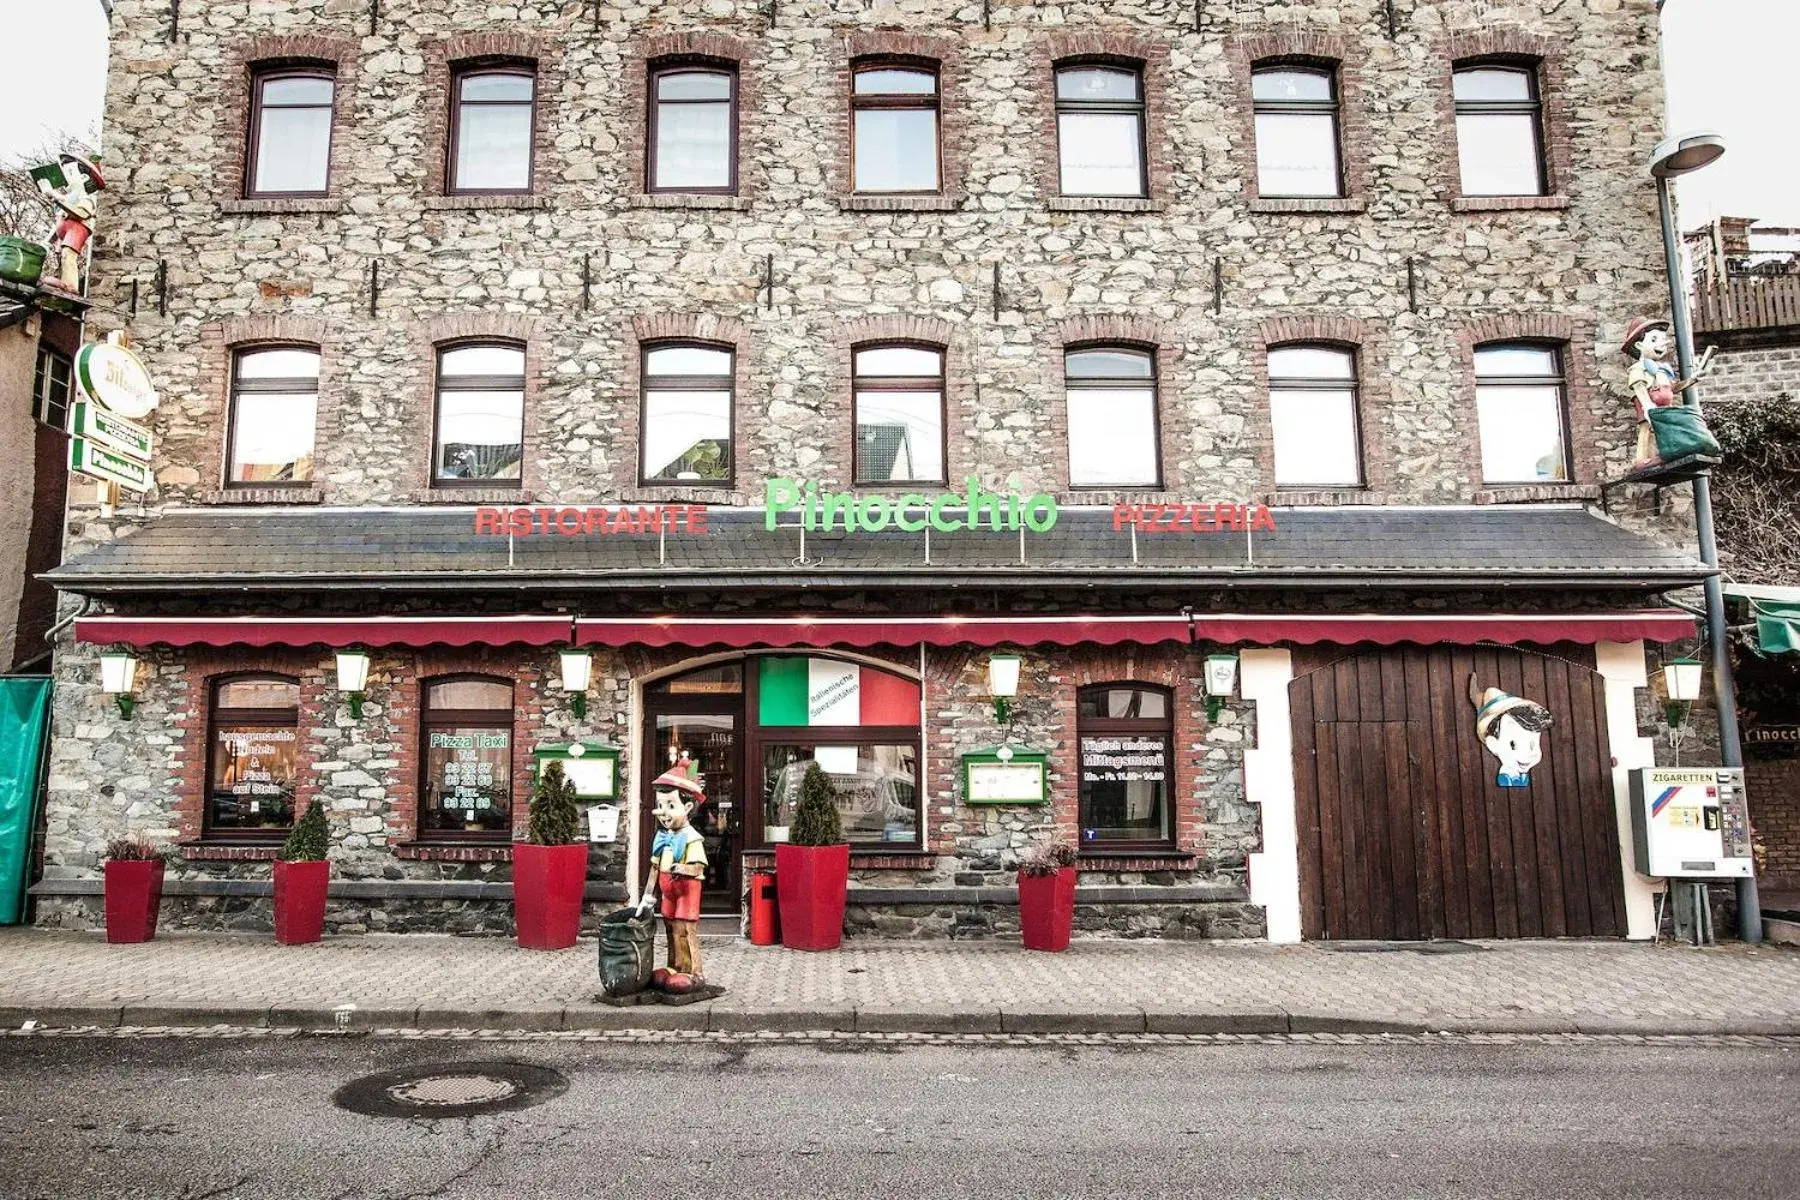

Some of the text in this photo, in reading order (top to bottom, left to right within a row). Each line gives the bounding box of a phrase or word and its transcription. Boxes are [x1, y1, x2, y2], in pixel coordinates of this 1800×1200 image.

[475, 475, 1277, 537] RISTORANTE Pinocchio PIZZERIA
[810, 672, 854, 703] Italienische
[810, 684, 859, 717] Spezialitäten
[430, 733, 508, 749] Pizza Taxi
[250, 756, 260, 768] &
[1083, 753, 1165, 769] Mittagsmenü
[1652, 773, 1713, 782] ZIGARETTEN
[232, 783, 281, 794] auf Stein
